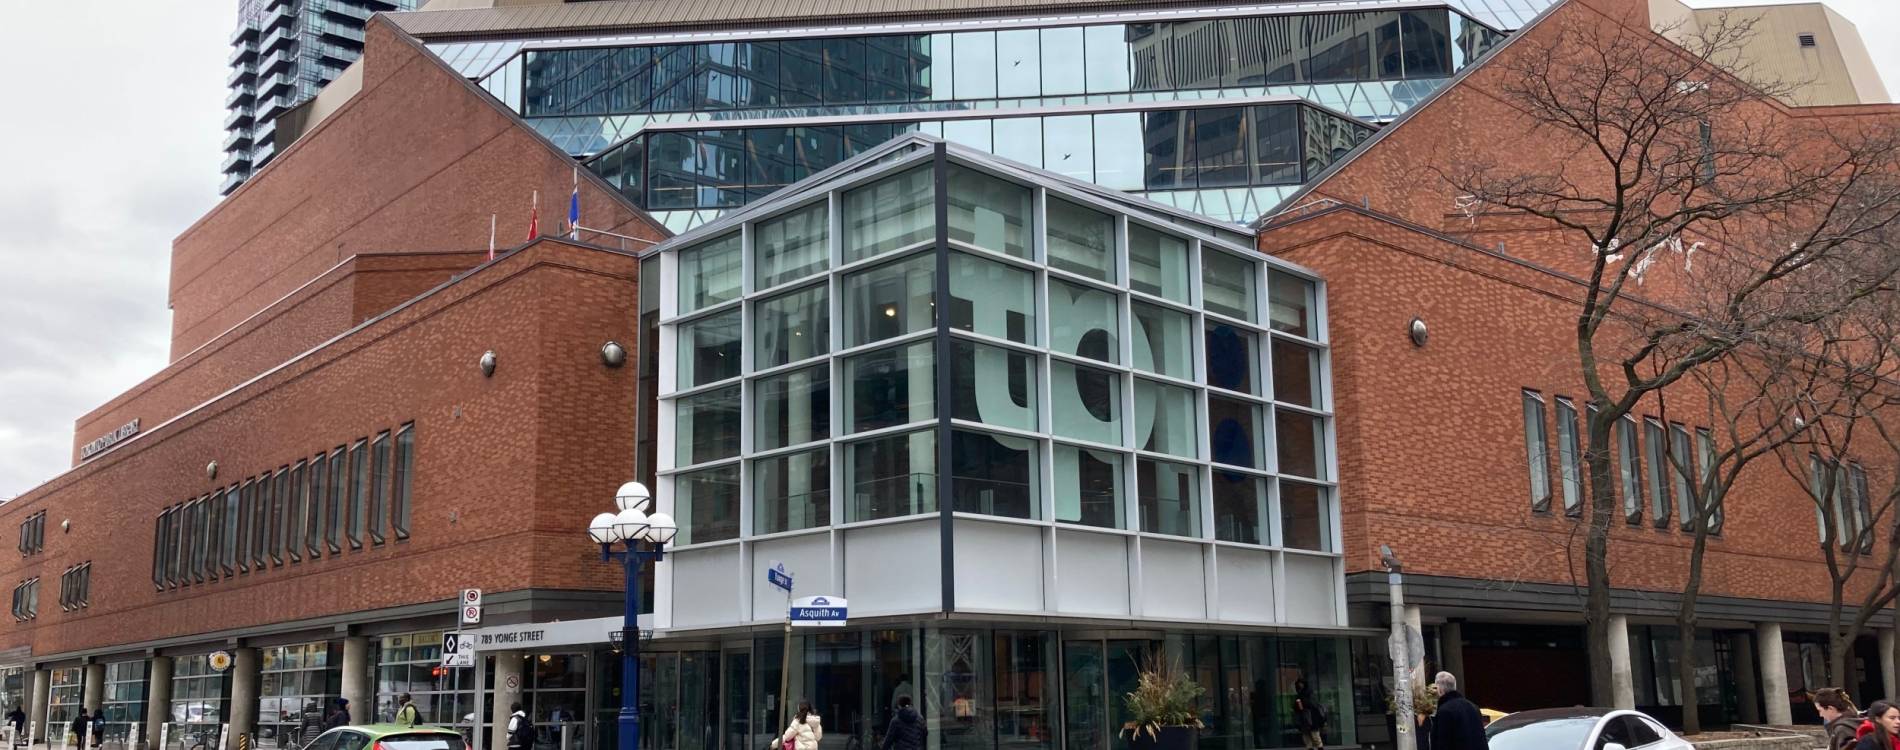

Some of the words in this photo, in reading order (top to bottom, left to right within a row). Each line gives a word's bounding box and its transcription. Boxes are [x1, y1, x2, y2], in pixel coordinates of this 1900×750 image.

[799, 608, 830, 619] Asquith
[831, 610, 840, 618] Av
[481, 634, 493, 645] 789
[494, 632, 518, 643] YONGE
[519, 630, 545, 642] STREET
